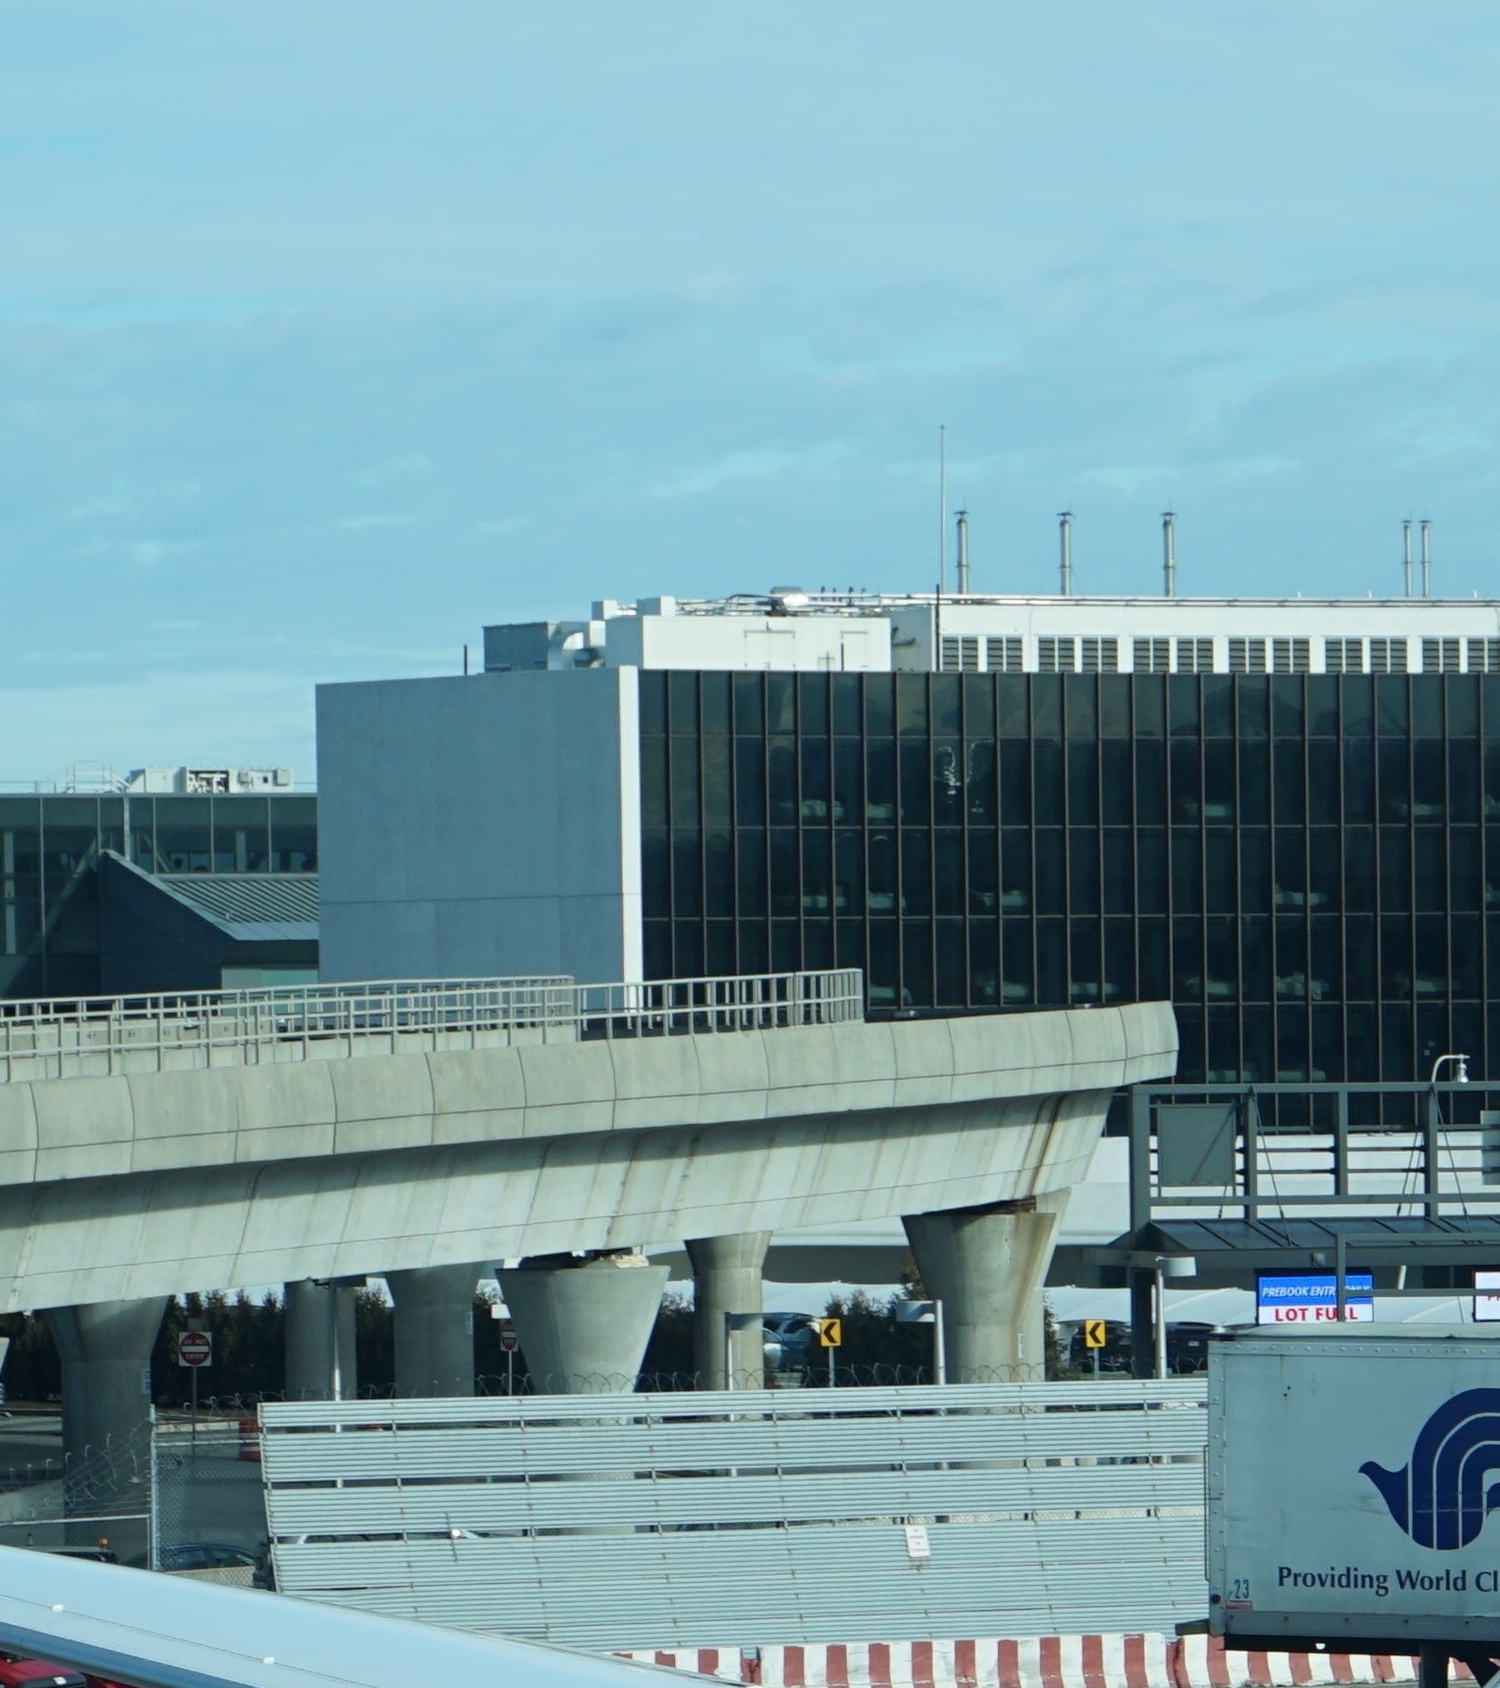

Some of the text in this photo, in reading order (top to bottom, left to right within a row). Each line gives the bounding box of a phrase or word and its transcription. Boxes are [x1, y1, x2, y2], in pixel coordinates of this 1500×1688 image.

[1262, 1286, 1308, 1297] PREBOOK
[1309, 1286, 1338, 1297] ENTR
[1275, 1307, 1357, 1321] LOT FUL
[1278, 1566, 1389, 1597] Providing
[1396, 1568, 1467, 1594] World
